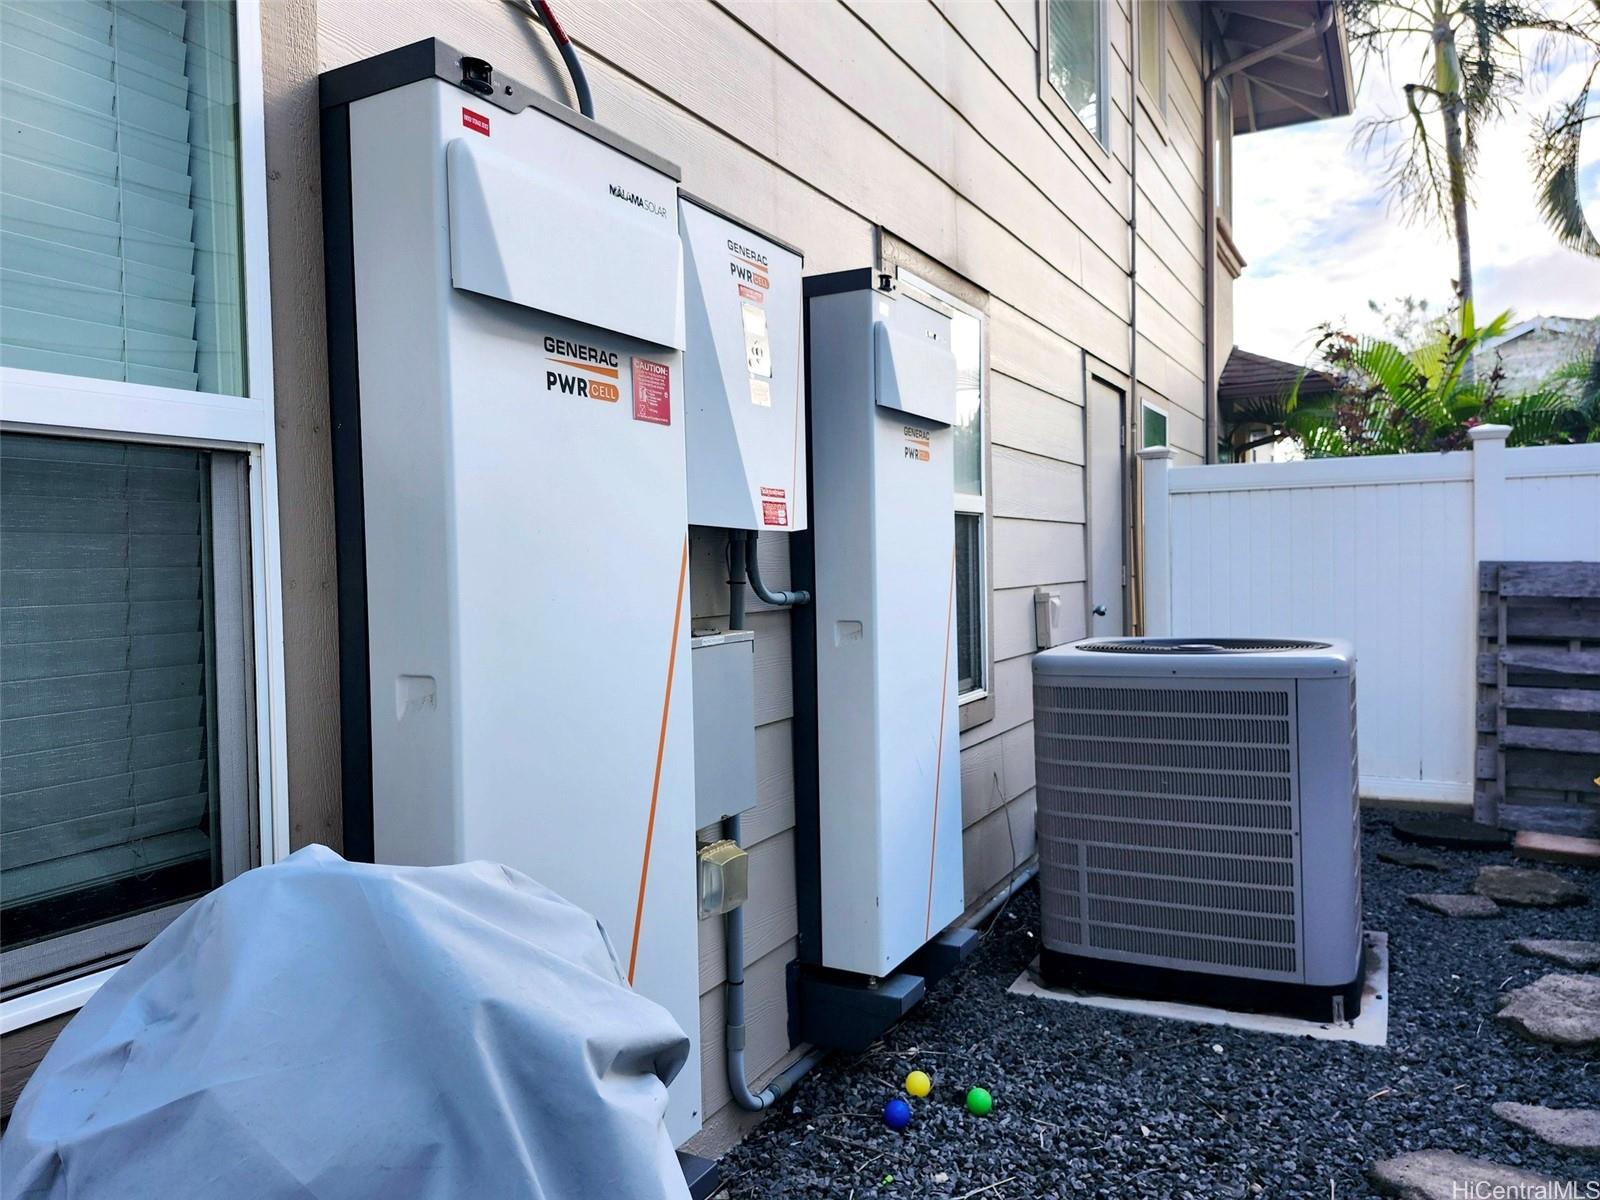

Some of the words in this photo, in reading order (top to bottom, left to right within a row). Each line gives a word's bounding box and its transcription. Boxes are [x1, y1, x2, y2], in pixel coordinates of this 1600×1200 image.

[728, 239, 768, 266] GENERAC
[544, 336, 618, 368] GENERAC
[904, 426, 930, 441] GENERAC
